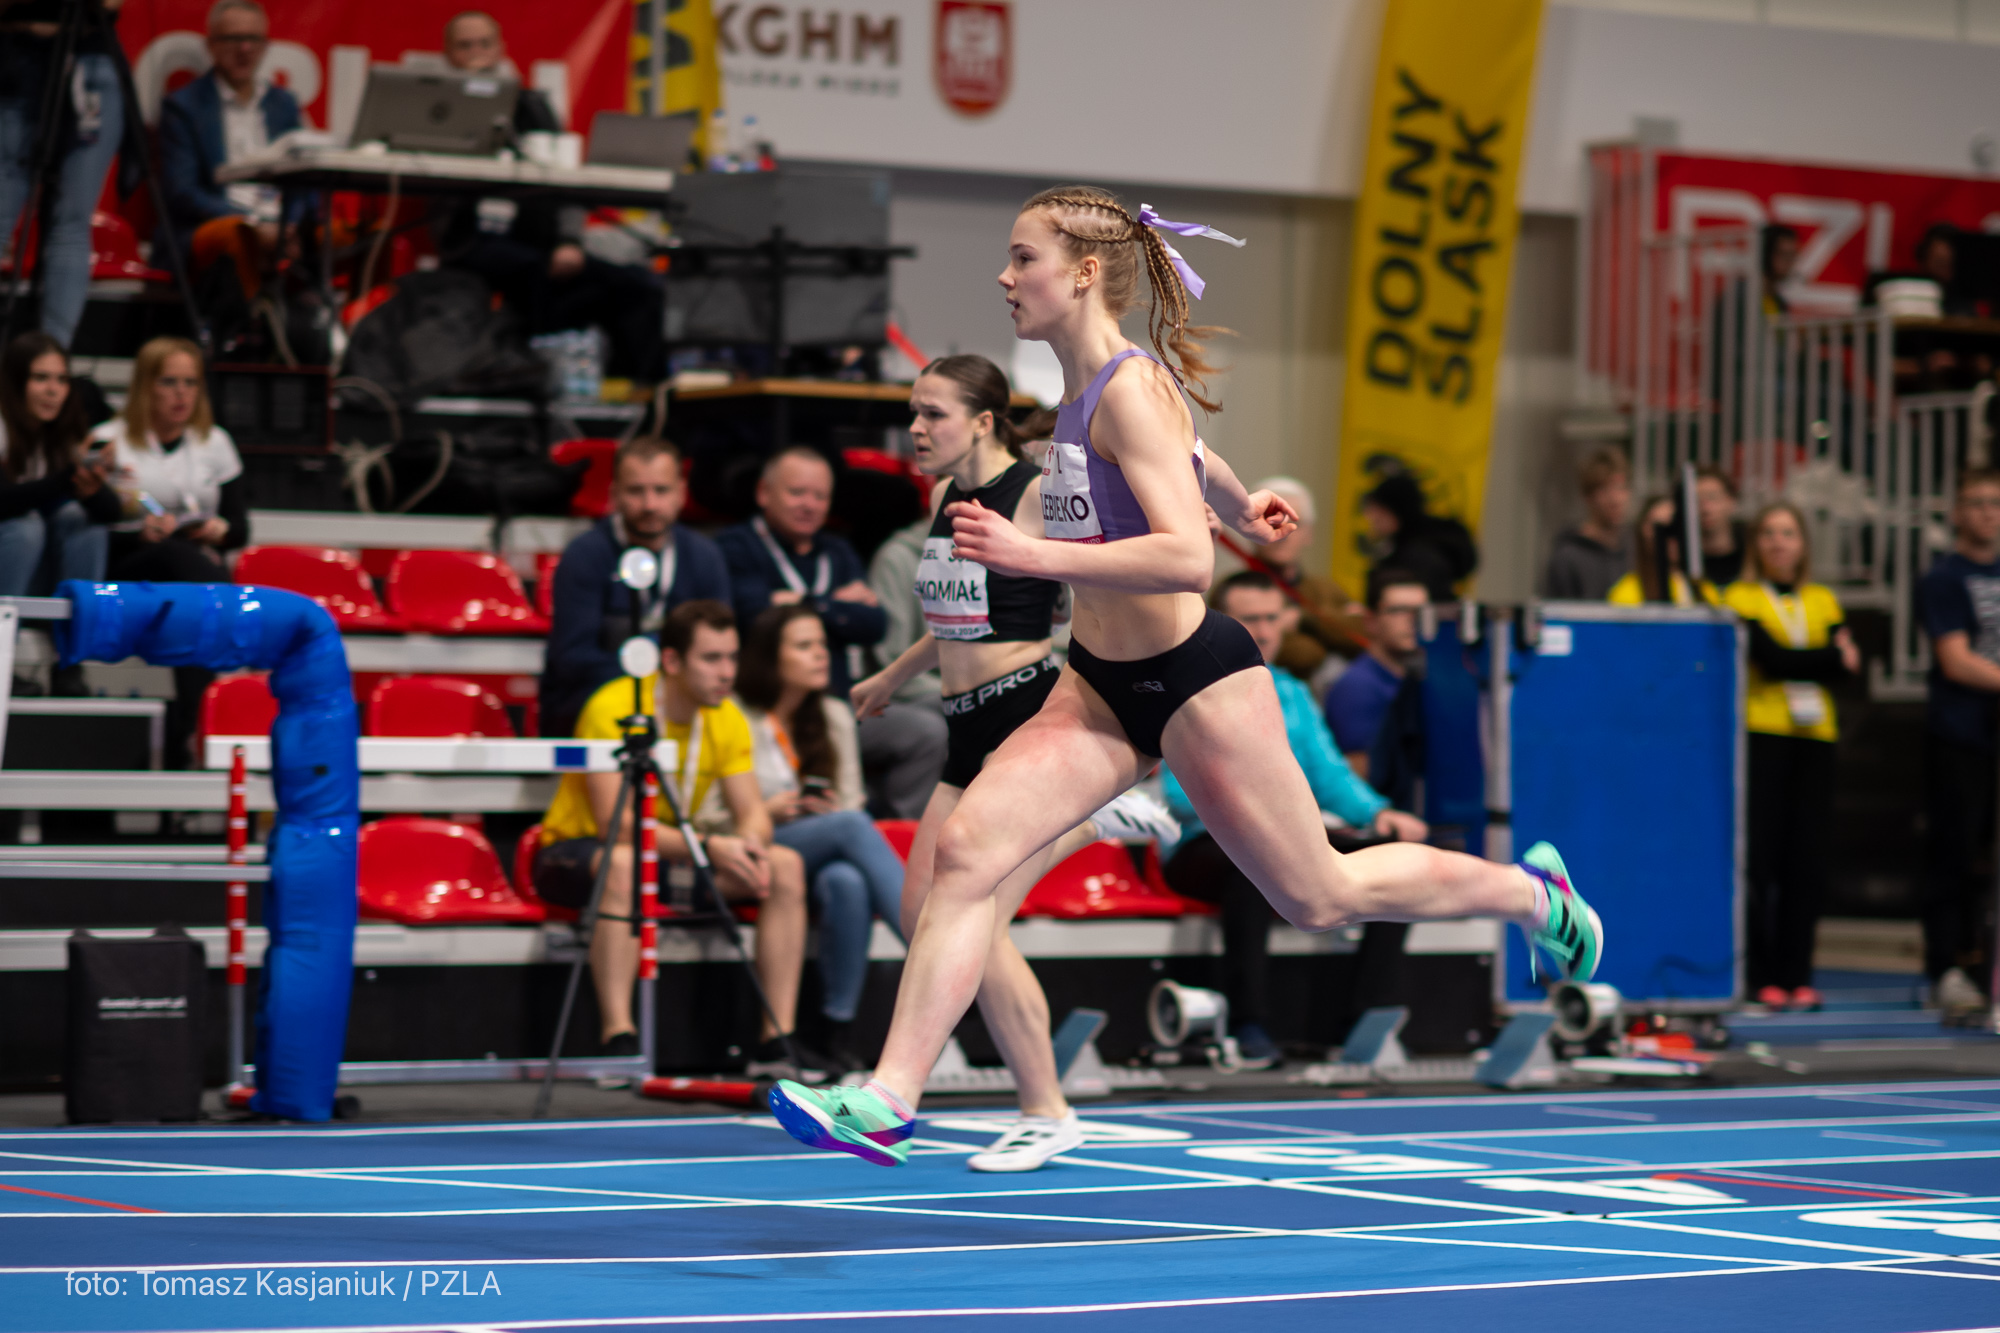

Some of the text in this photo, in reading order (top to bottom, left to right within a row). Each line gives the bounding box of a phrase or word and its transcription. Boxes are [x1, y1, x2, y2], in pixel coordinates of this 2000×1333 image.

[1366, 69, 1442, 389] DOLNY
[977, 666, 1037, 705] PRO
[1462, 1177, 1746, 1206] 4
